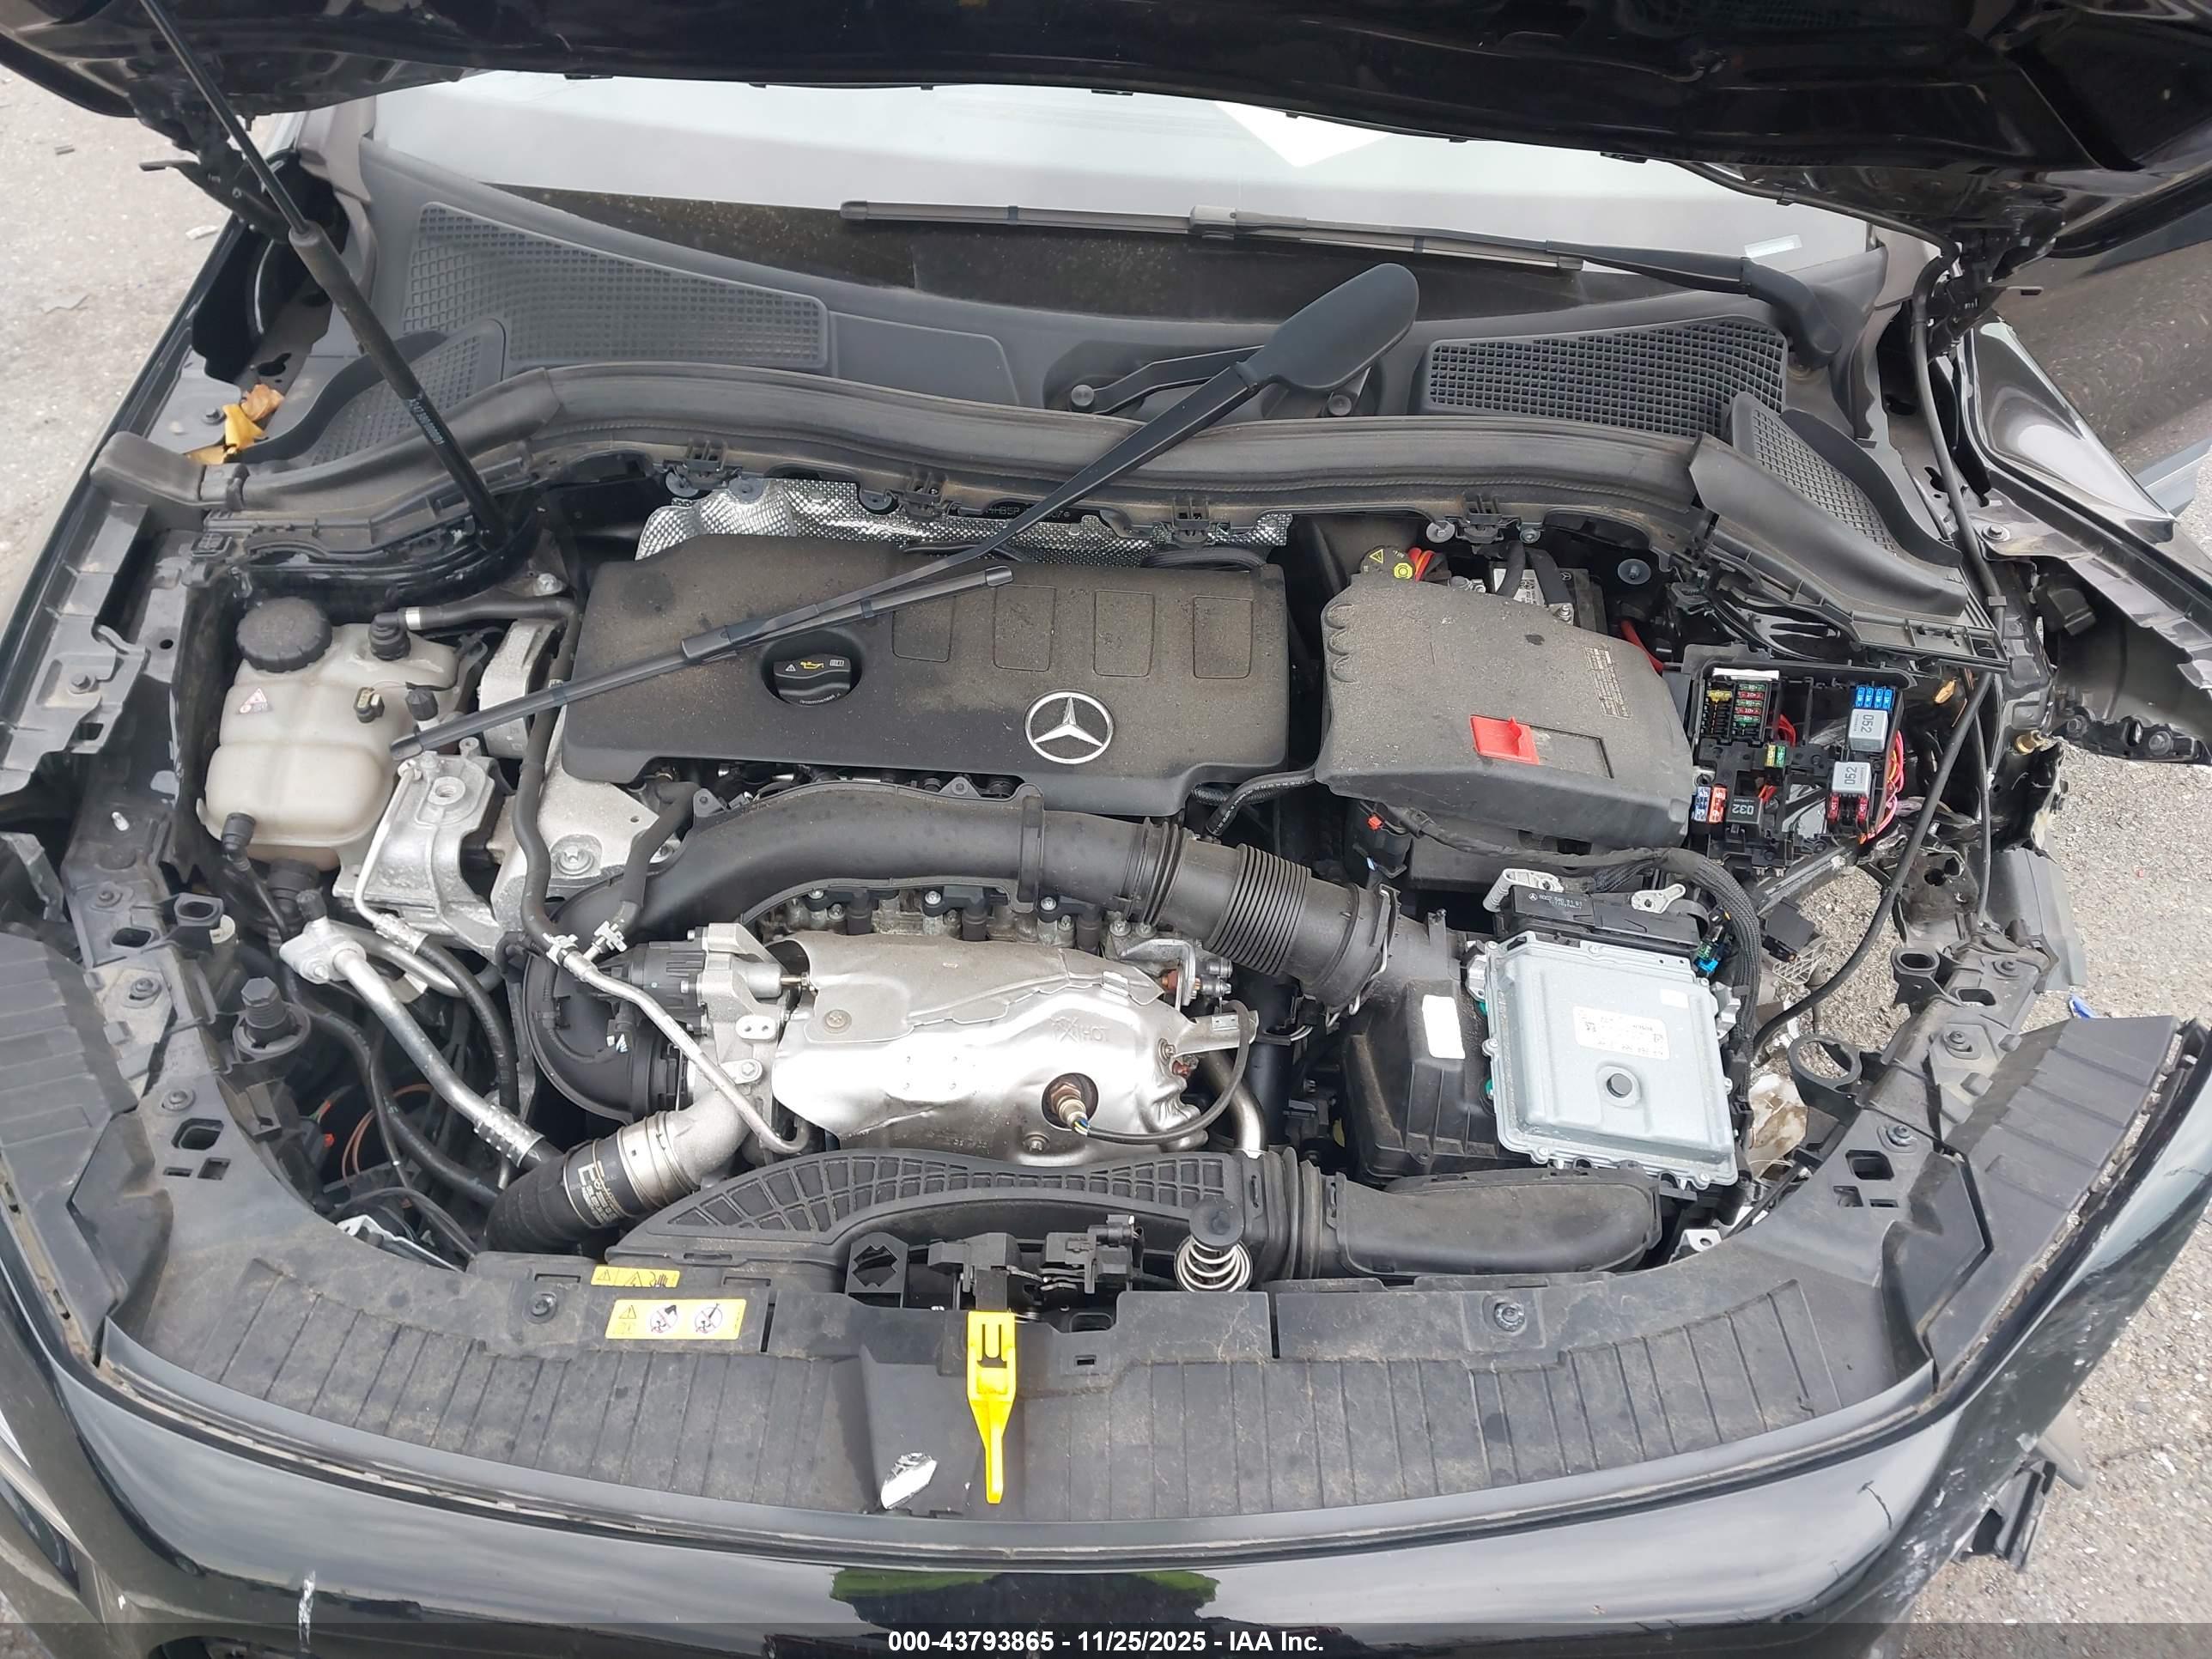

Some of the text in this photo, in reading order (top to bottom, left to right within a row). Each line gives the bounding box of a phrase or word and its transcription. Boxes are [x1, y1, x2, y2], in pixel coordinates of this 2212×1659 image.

[1860, 714, 1875, 734] 052
[1844, 766, 1857, 785] 052
[1731, 804, 1755, 816] 032
